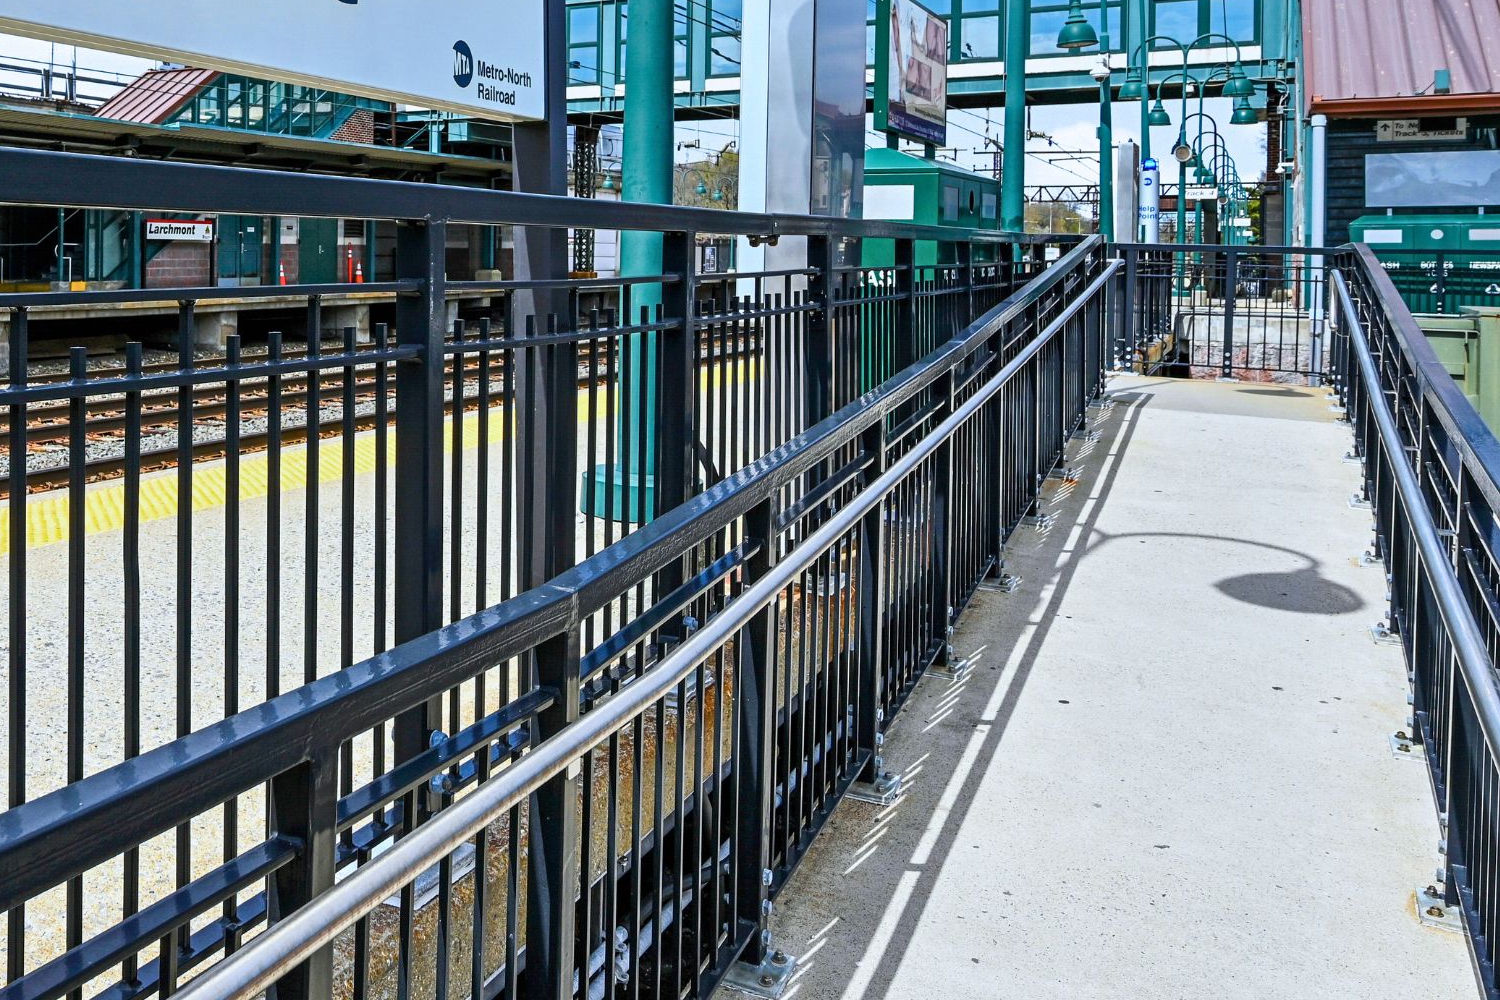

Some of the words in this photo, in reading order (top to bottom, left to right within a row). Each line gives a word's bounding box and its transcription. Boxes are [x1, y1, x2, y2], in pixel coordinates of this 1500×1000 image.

[477, 60, 531, 88] Metro-North
[477, 83, 516, 106] Railroad
[148, 223, 196, 235] Larchmont
